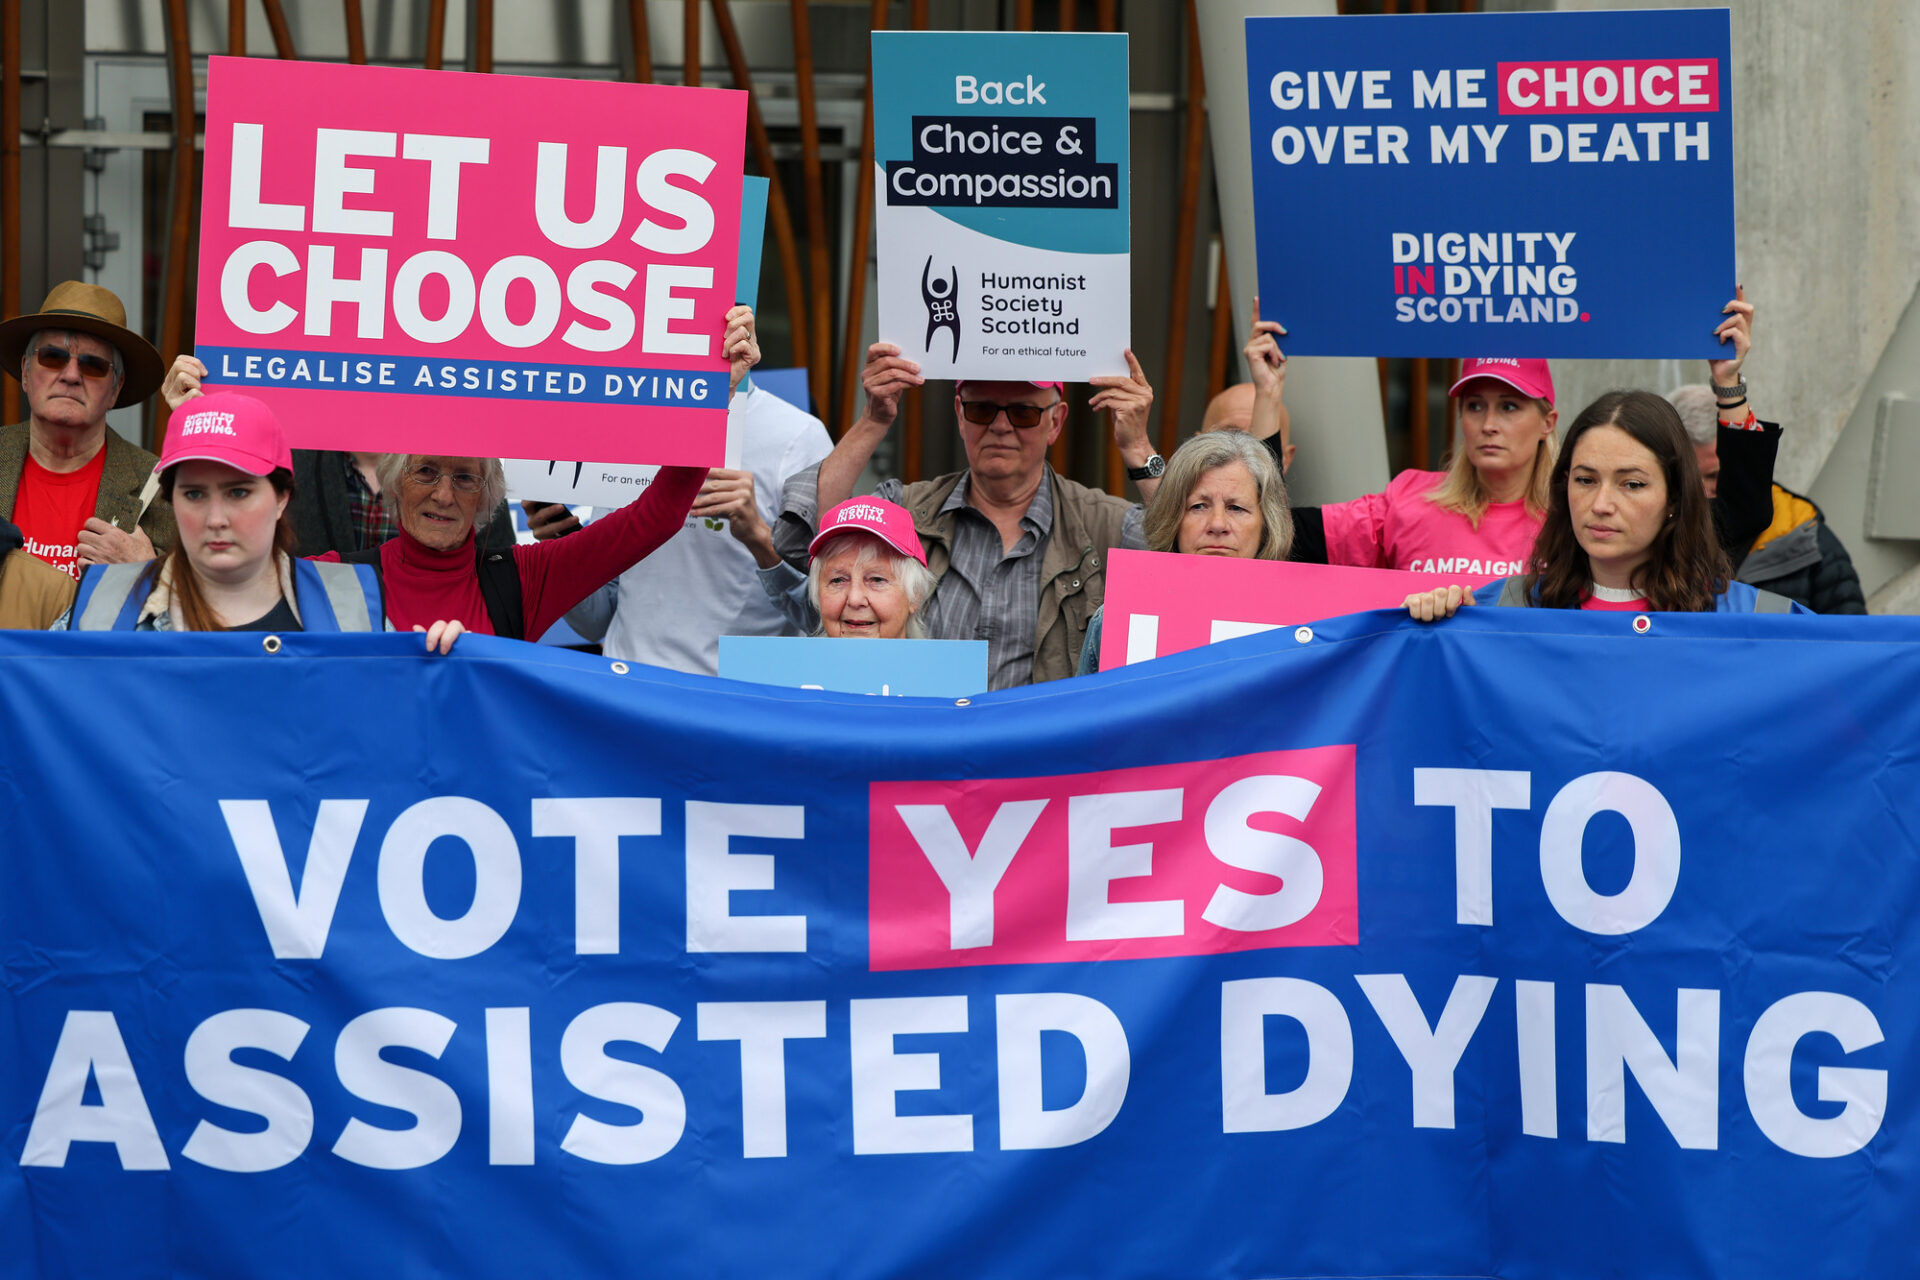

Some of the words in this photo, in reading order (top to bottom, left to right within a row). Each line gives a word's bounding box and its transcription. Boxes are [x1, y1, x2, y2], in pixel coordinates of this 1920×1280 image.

[955, 74, 1047, 105] Back
[1270, 70, 1392, 110] GIVE
[1412, 69, 1487, 109] ME
[1506, 65, 1710, 108] CHOICE
[920, 123, 1043, 154] Choice
[1055, 125, 1083, 155] &
[1271, 125, 1410, 165] OVER
[1430, 124, 1509, 164] MY
[1529, 122, 1710, 163] DEATH
[228, 122, 490, 240] LET
[535, 141, 717, 254] US
[893, 166, 1111, 204] Compassion
[1392, 232, 1577, 264] DIGNITY
[981, 272, 1086, 290] Humanist
[1393, 265, 1435, 295] IN
[1444, 264, 1577, 296] DYING
[220, 240, 714, 356] CHOOSE
[981, 295, 1063, 316] Society
[1395, 297, 1591, 323] SCOTLAND.
[981, 317, 1079, 335] Scotland
[982, 345, 999, 355] For
[1002, 347, 1015, 355] an
[1018, 346, 1052, 356] ethical
[1055, 347, 1087, 357] future
[222, 354, 396, 385] LEGALISE
[414, 365, 587, 394] ASSISTED
[604, 373, 709, 400] DYING
[601, 473, 618, 482] For
[620, 476, 633, 484] an
[1410, 557, 1523, 576] CAMPAIGN
[218, 795, 808, 960] VOTE
[894, 774, 1324, 950] YES
[1414, 767, 1681, 936] TO
[19, 992, 1132, 1173] ASSISTED
[1221, 973, 1889, 1158] DYING
